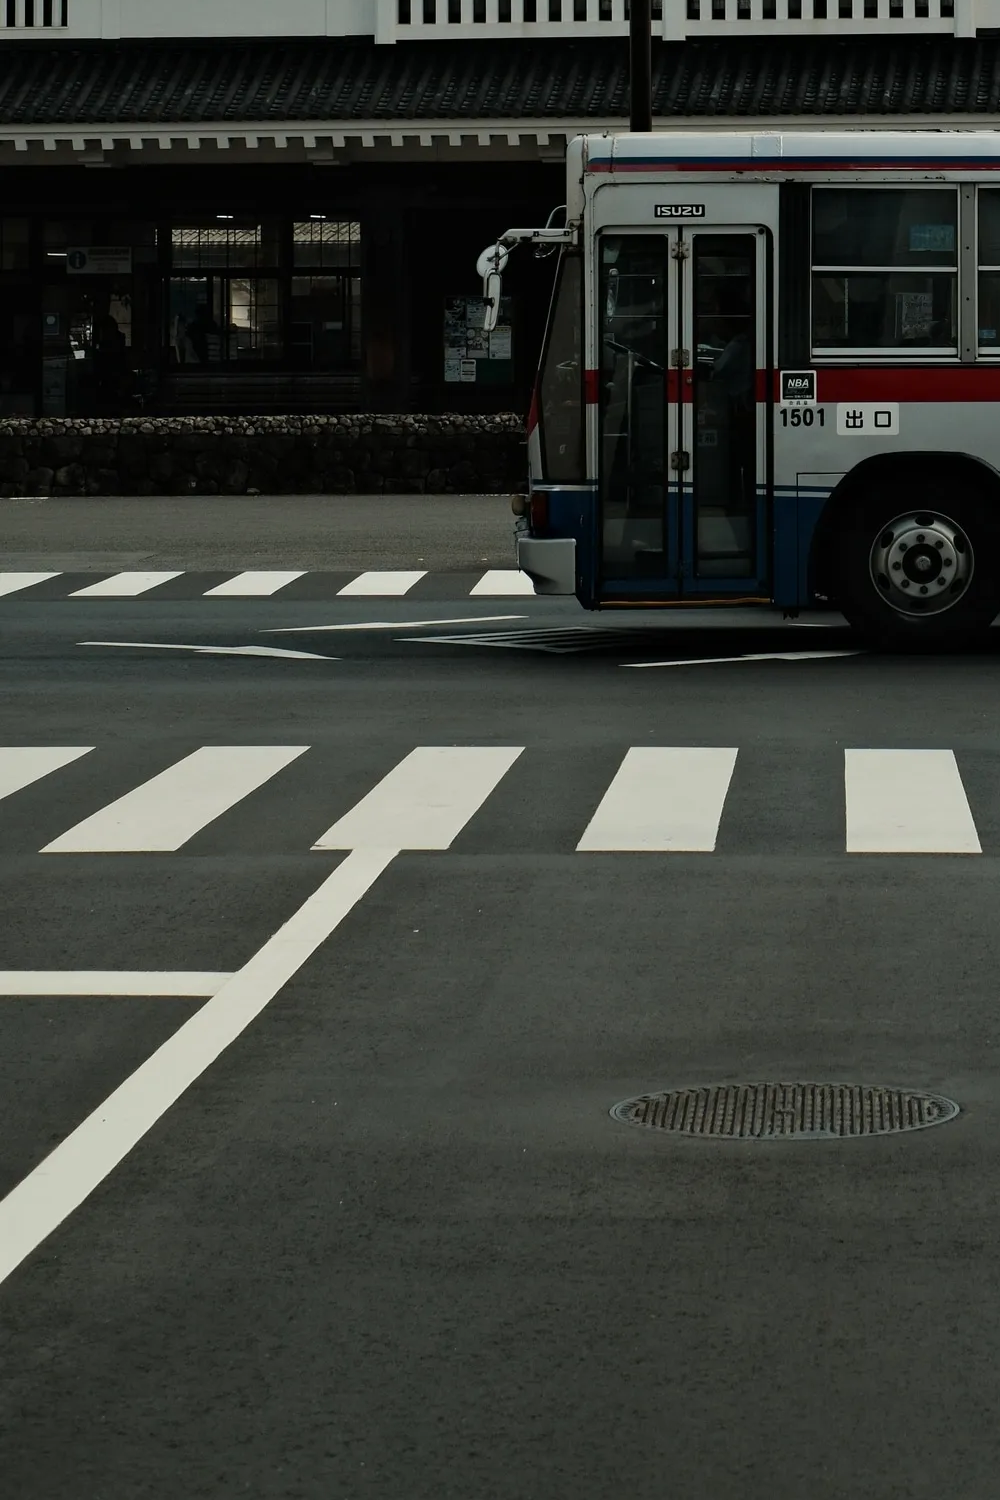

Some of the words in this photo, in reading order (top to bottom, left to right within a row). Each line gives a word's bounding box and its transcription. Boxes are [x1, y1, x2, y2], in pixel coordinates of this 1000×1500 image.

[656, 206, 703, 216] ISUZU
[787, 378, 809, 388] NBA
[779, 408, 825, 427] 1501
[845, 409, 892, 429] 出口
